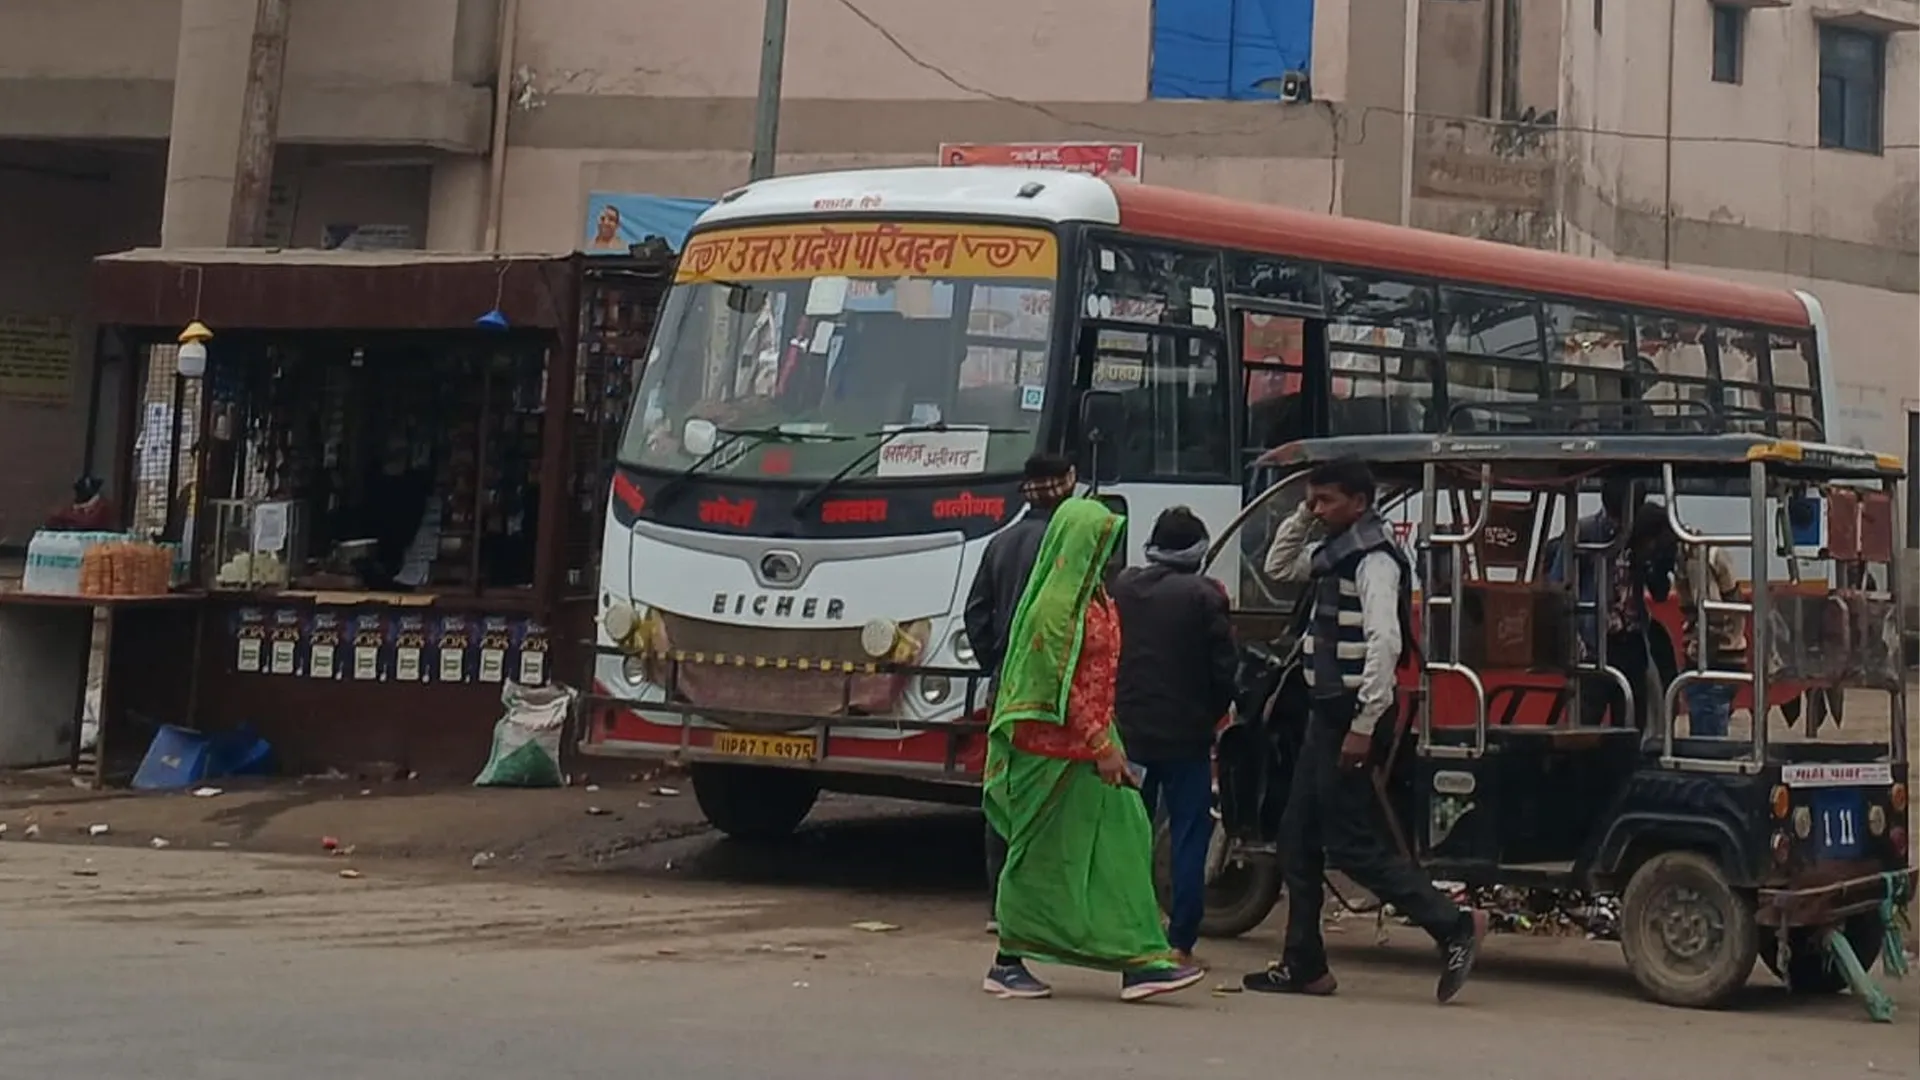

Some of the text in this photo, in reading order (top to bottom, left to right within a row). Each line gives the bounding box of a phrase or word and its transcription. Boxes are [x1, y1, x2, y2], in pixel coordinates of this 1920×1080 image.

[729, 224, 957, 273] उत्तर प्रदेश परिवहन
[713, 593, 846, 621] EICHER
